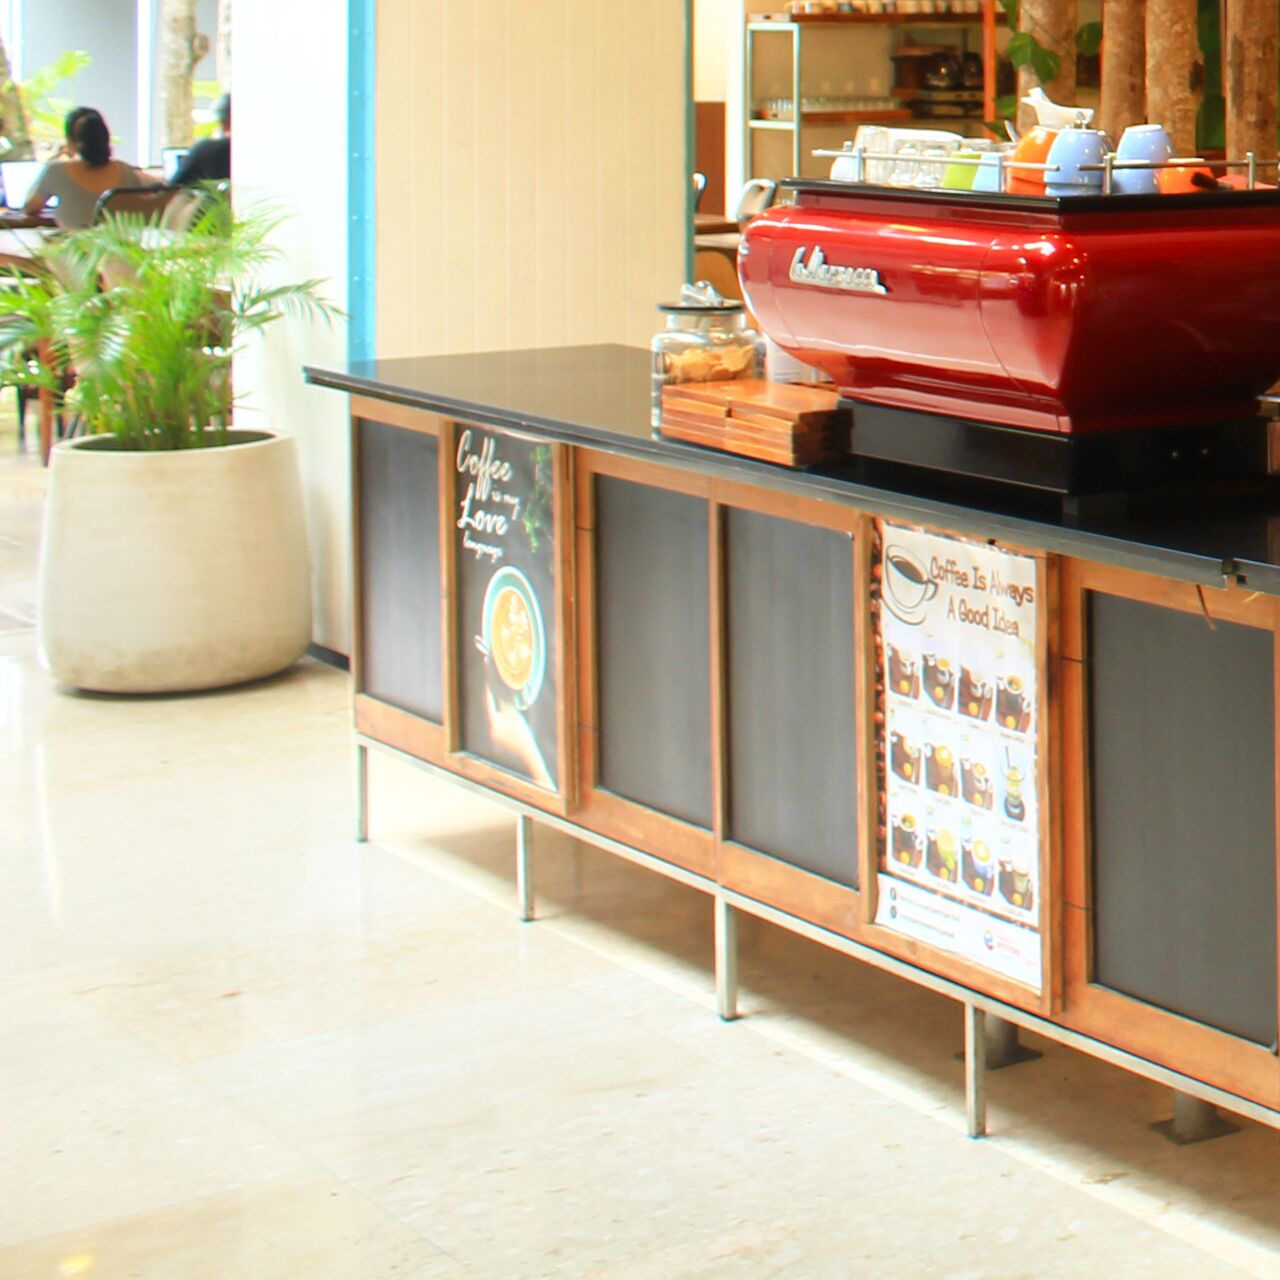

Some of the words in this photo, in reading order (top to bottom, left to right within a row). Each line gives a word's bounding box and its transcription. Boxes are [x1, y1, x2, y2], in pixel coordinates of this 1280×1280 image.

[457, 429, 514, 502] Coffee
[457, 482, 509, 536] Love
[929, 556, 969, 588] Coffee
[972, 566, 987, 591] Is
[990, 569, 1035, 606] Always
[947, 595, 957, 621] A
[958, 598, 989, 631] Good
